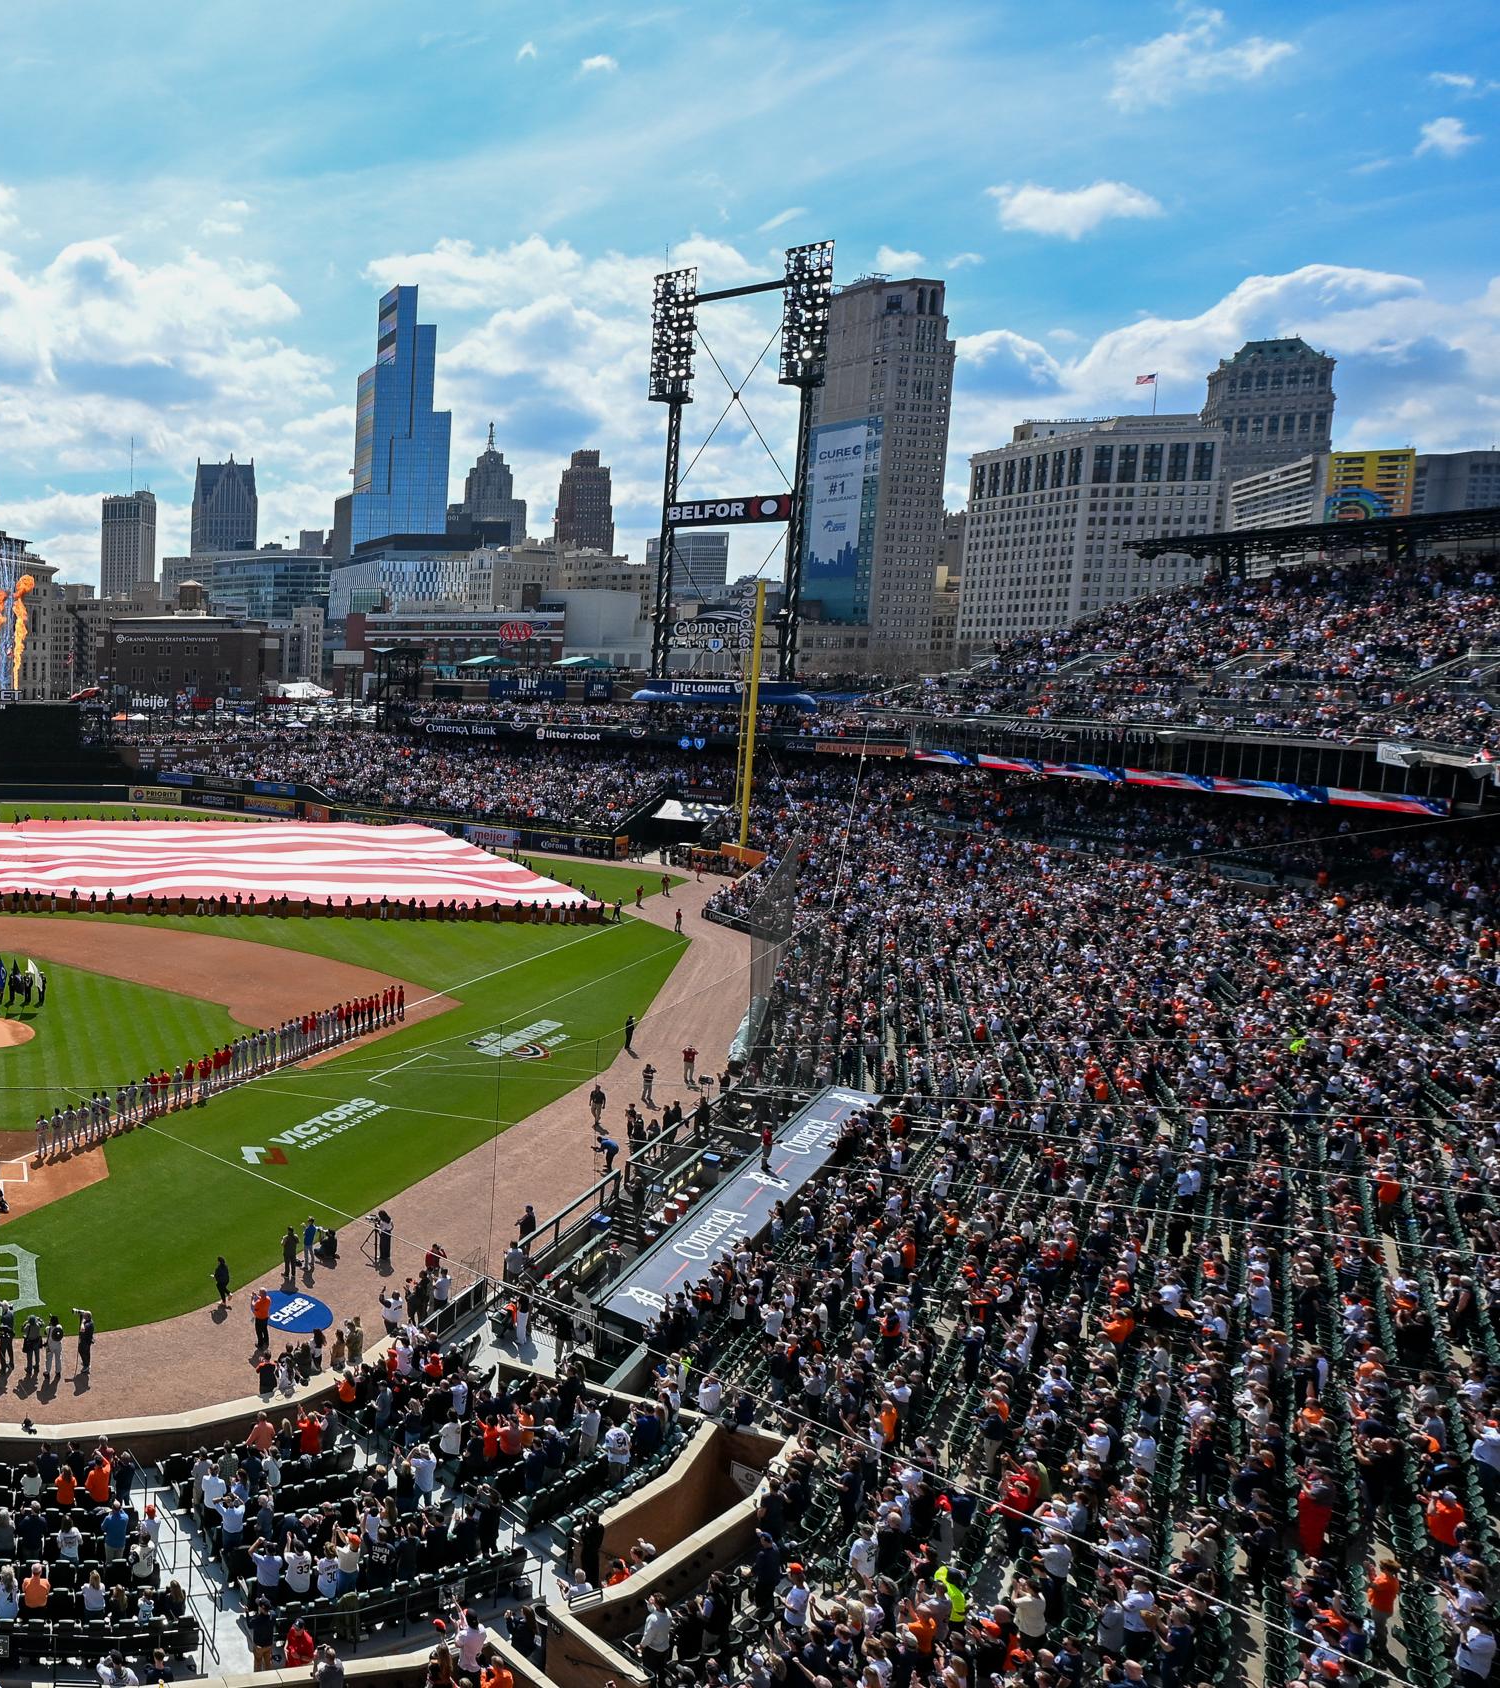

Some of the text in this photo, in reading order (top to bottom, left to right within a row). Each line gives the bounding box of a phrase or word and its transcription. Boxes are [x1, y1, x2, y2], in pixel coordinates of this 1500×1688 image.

[819, 446, 852, 461] CURE
[824, 472, 854, 481] MICHIGAN'S
[829, 481, 845, 496] #1
[828, 494, 858, 503] INSURANCE
[668, 502, 745, 521] BELFOR
[501, 622, 533, 640] AAA
[738, 598, 757, 653] Rocket
[518, 678, 539, 691] Lite
[671, 682, 691, 694] Lite
[692, 684, 731, 694] LOUNGE
[132, 695, 170, 710] meijer
[471, 725, 497, 736] Bank
[1079, 728, 1155, 745] TIGER CLUB
[146, 790, 177, 798] PRIORITY
[474, 829, 509, 843] meijer
[540, 840, 568, 851] Corona
[268, 1097, 377, 1146] VICTORS
[297, 1104, 391, 1150] HOME SOLUTIONS
[269, 1300, 301, 1322] CURE
[371, 1551, 388, 1564] 24
[296, 1563, 309, 1575] 33
